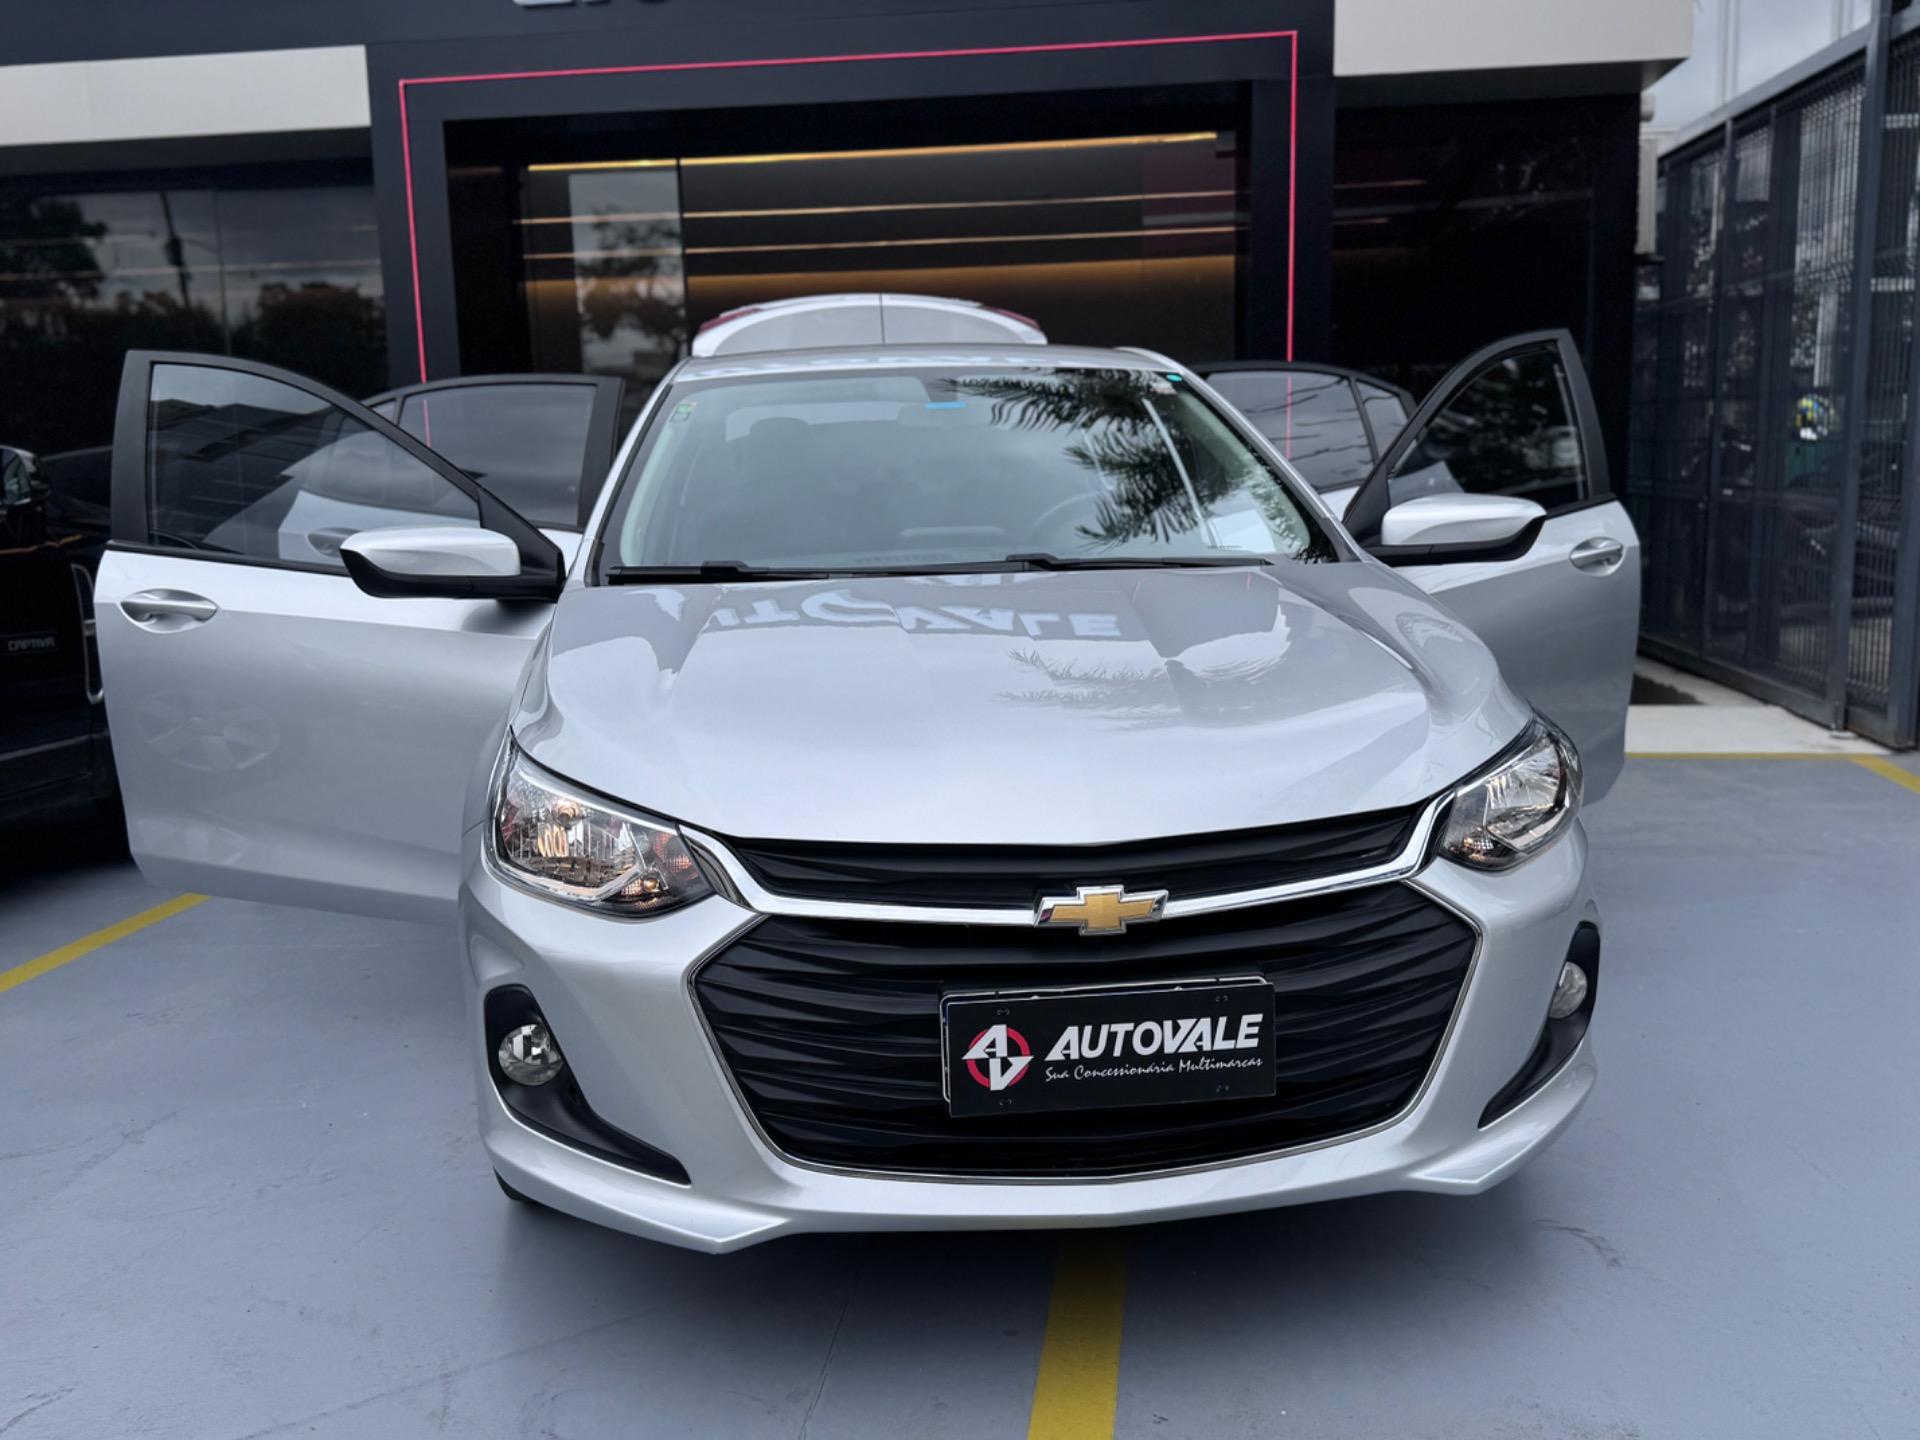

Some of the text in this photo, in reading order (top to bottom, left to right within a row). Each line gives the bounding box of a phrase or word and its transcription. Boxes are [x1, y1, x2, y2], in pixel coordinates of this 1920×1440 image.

[1044, 1013, 1263, 1062] AUTOVALE
[1045, 1056, 1263, 1082] Sua Concessionária Multimarcas
